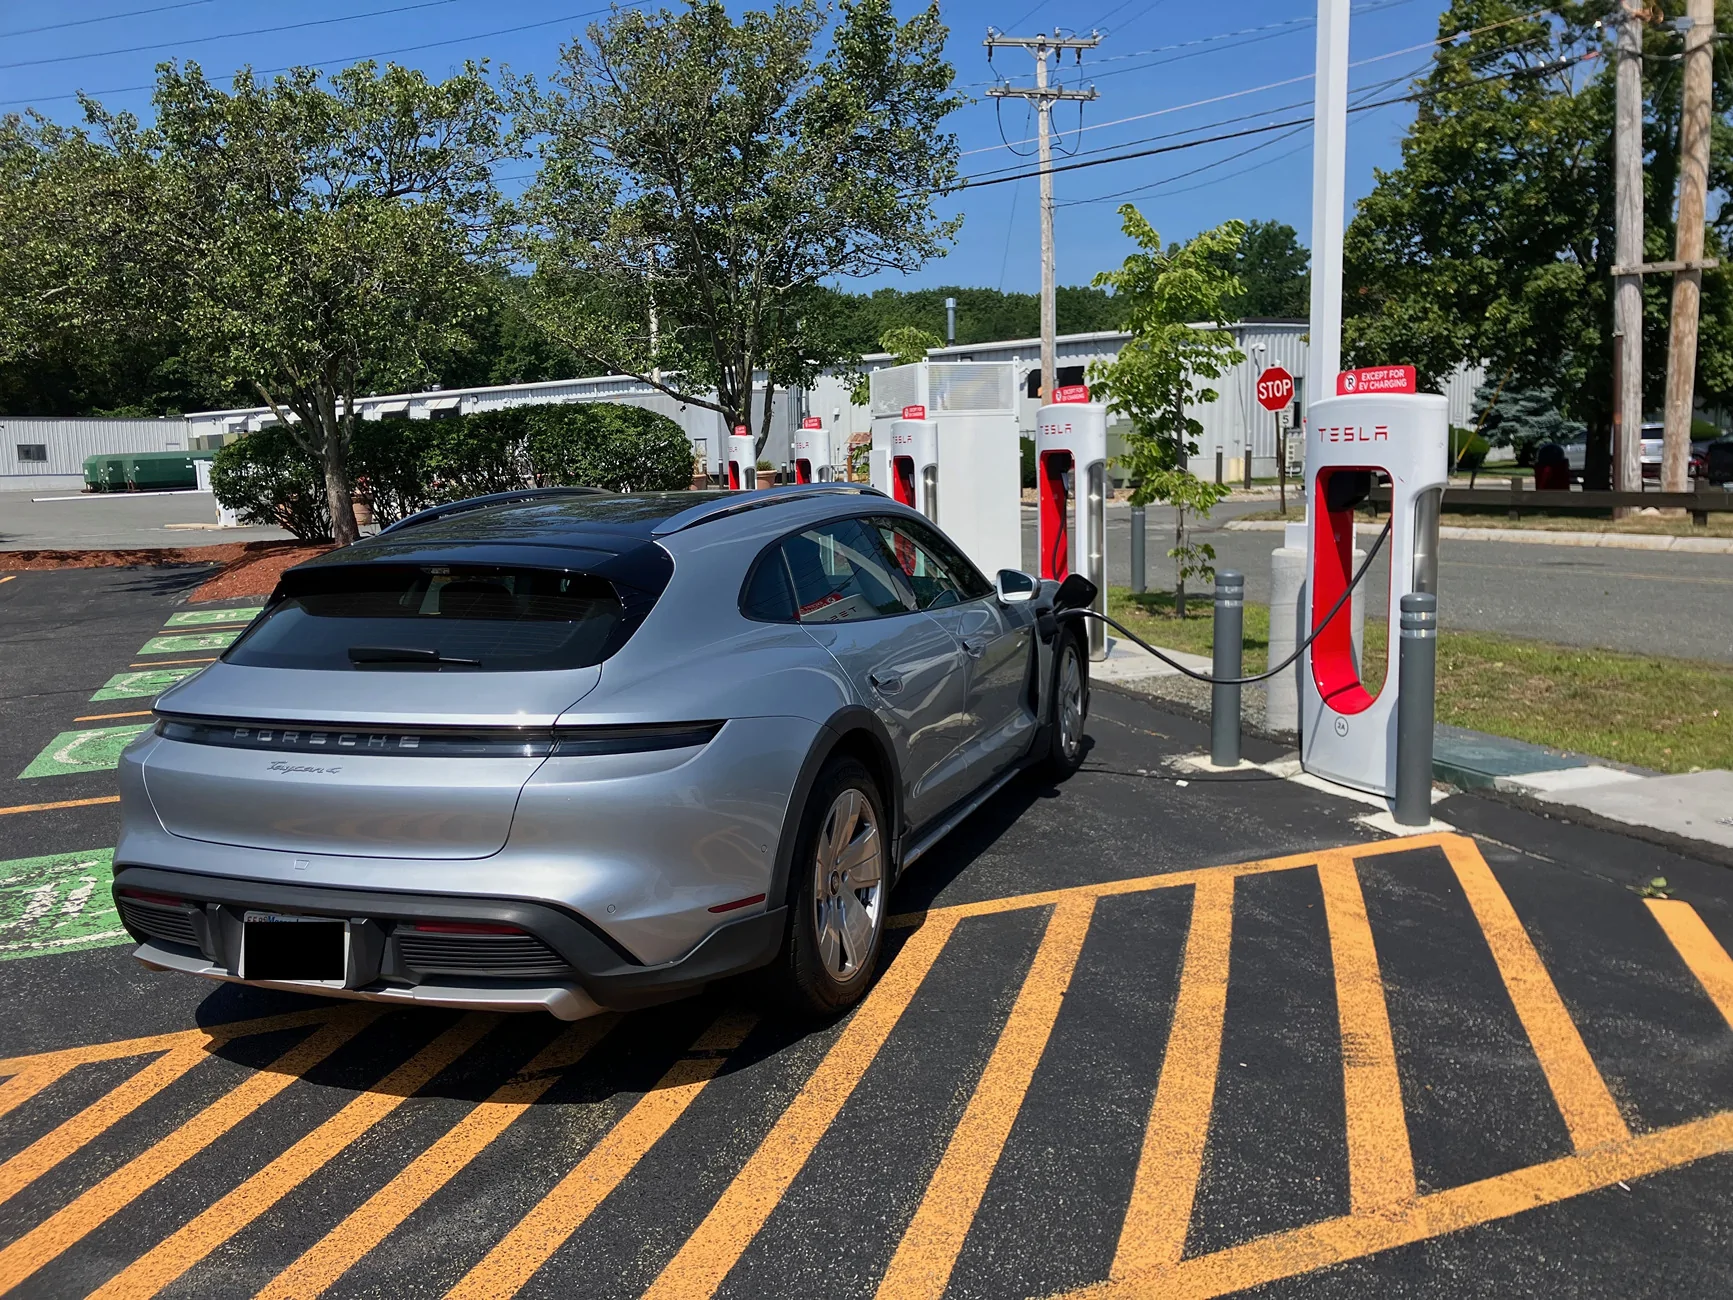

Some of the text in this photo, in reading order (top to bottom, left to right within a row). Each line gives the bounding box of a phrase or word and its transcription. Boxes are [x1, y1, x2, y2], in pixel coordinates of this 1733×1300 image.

[1361, 369, 1404, 381] EXCEPT FOR
[1258, 379, 1291, 399] STOP
[1369, 379, 1407, 389] CHARGING
[1282, 414, 1289, 424] 5
[1318, 426, 1388, 442] TESLA
[234, 728, 420, 748] PORSCHE
[267, 761, 324, 774] Taycan
